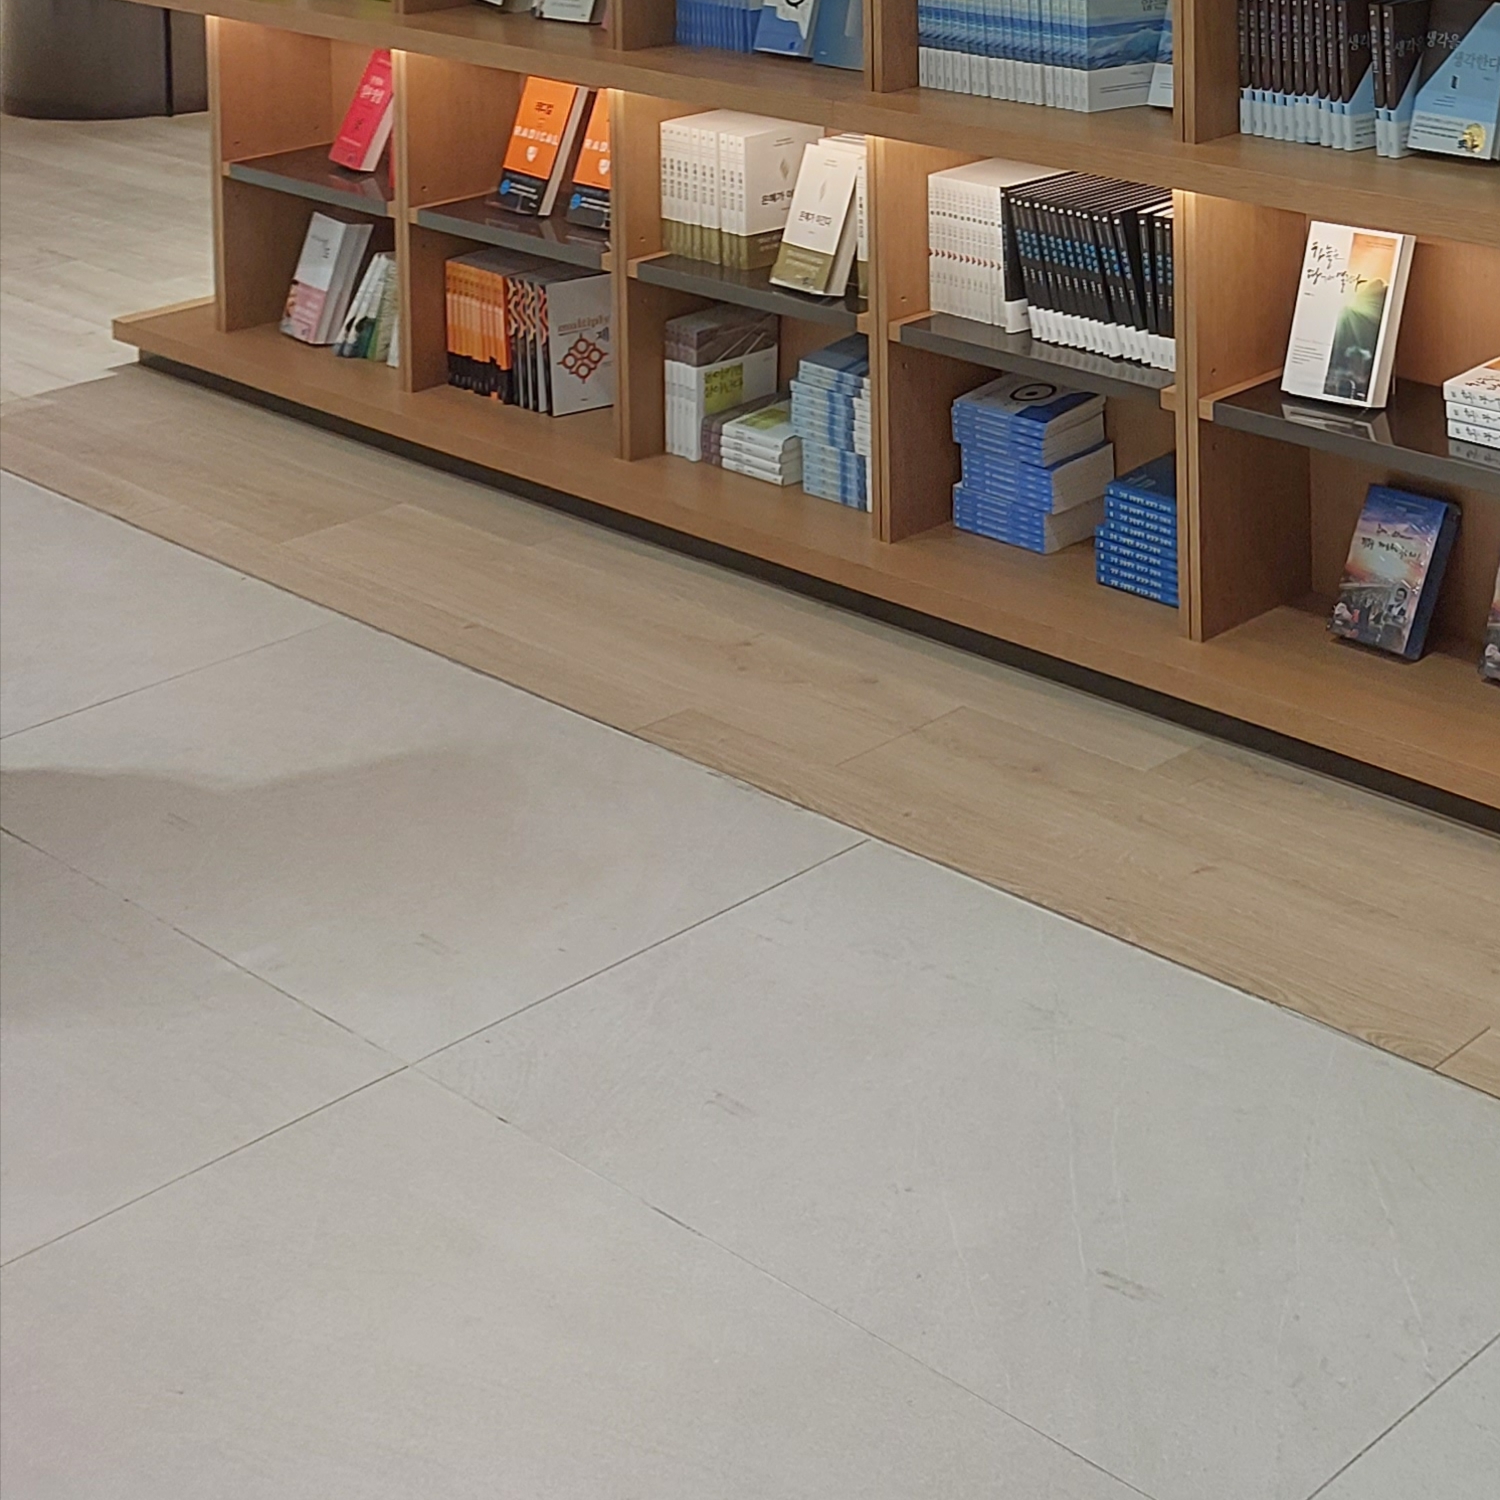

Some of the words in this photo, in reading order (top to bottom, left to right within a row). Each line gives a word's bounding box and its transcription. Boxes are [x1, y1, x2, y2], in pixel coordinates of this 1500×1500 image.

[1427, 30, 1462, 50] 생각을
[513, 125, 559, 145] RADICAL
[585, 138, 611, 153] RAD
[558, 315, 610, 332] multiply
